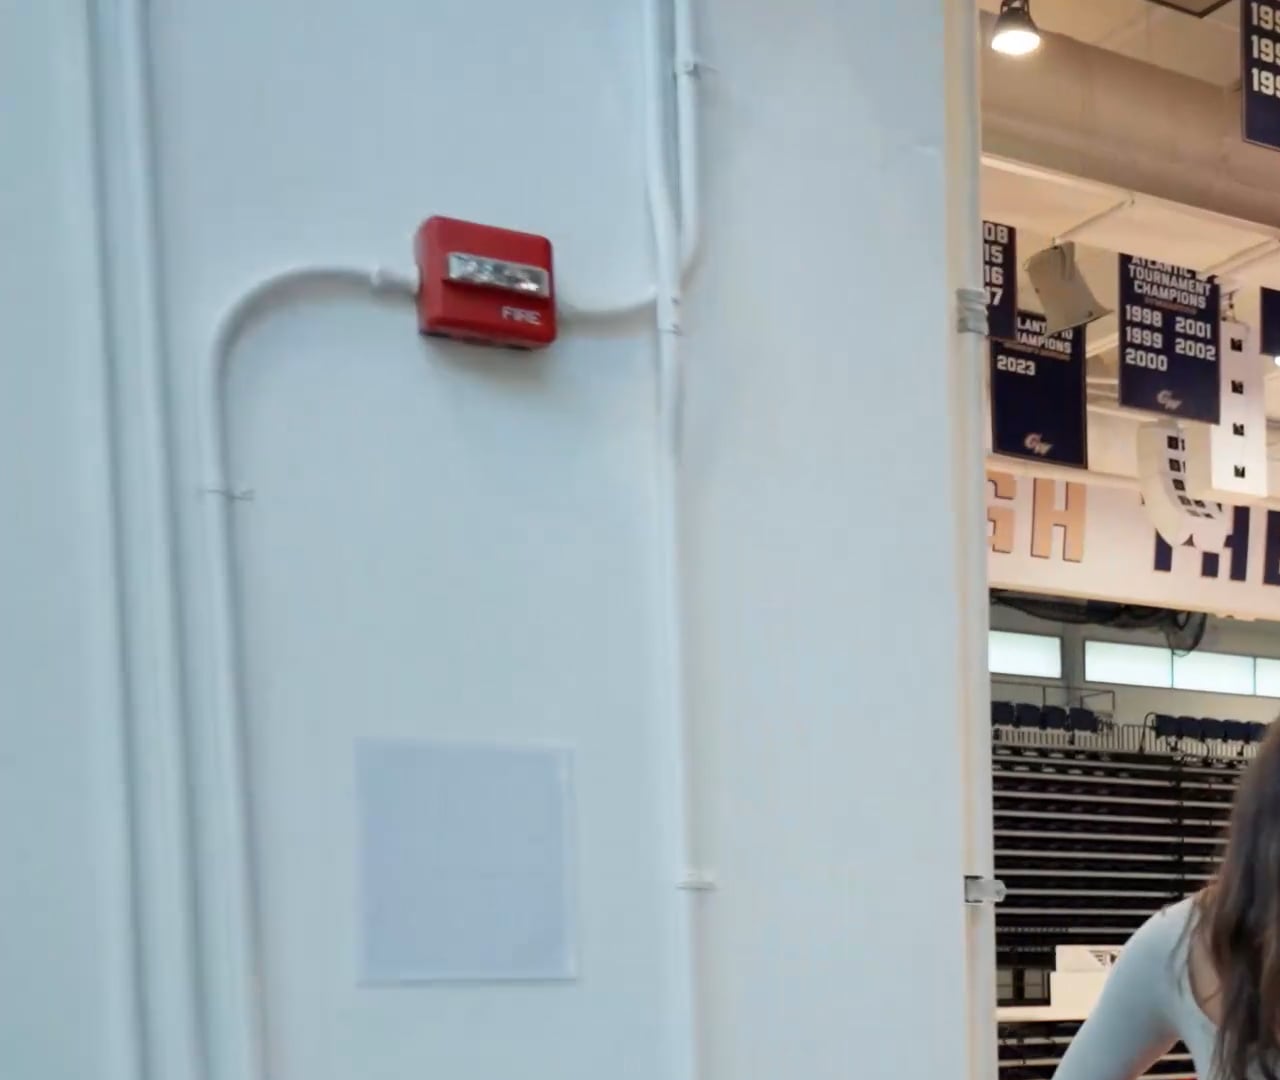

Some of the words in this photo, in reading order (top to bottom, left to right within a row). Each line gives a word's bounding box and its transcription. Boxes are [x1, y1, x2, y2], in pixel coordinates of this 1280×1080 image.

[983, 223, 1009, 244] 08
[984, 244, 1003, 263] 15
[984, 265, 1004, 285] 16
[1128, 264, 1212, 296] TOURNAMENT
[1133, 280, 1207, 309] CHAMPIONS
[1125, 305, 1163, 328] 1998
[1175, 316, 1212, 339] 2001
[1125, 327, 1163, 349] 1999
[1175, 338, 1217, 361] 2002
[996, 355, 1037, 376] 2023
[1125, 348, 1169, 372] 2000
